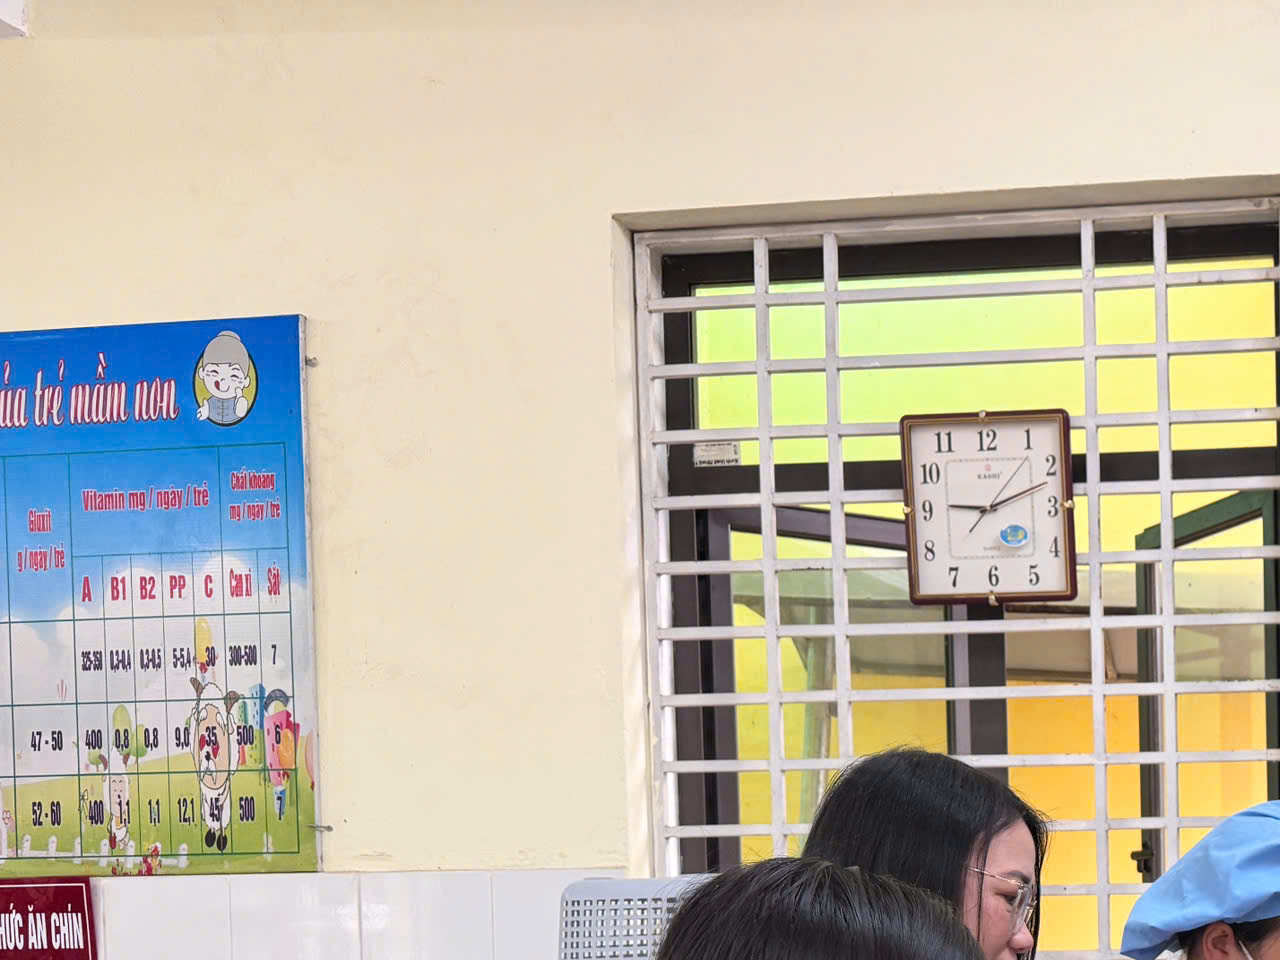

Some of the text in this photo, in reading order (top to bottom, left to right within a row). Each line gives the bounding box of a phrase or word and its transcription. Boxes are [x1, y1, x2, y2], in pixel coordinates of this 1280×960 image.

[33, 358, 65, 427] trẻ
[69, 351, 130, 426] mầm
[133, 375, 181, 421] non
[934, 431, 954, 454] 11
[977, 428, 998, 452] 12
[1024, 427, 1034, 450] 1
[920, 462, 941, 485] 10
[1045, 454, 1058, 477] 2
[82, 488, 126, 512] Vitamin
[128, 490, 146, 512] mg
[156, 485, 183, 511] ngày
[193, 481, 209, 506] trẻ
[1047, 495, 1060, 518] 3
[28, 508, 52, 533] Gluxit
[922, 499, 934, 522] 9
[17, 551, 23, 573] g
[29, 546, 48, 572] ngày
[924, 539, 936, 562] 8
[1049, 536, 1061, 559] 4
[139, 575, 156, 600] B2
[169, 574, 186, 599] PP
[204, 574, 213, 599] C
[229, 567, 252, 598] Can xi
[267, 560, 281, 597] Sắt
[948, 566, 960, 588] 7
[988, 565, 1000, 588] 6
[1028, 564, 1041, 587] 5
[81, 575, 92, 602] A
[110, 576, 126, 601] B1
[172, 647, 192, 671] 5-5,4
[205, 646, 216, 668] 30
[228, 644, 258, 667] 300-500
[271, 644, 277, 665] 7
[30, 730, 43, 752] 47
[51, 729, 63, 752] 50
[85, 729, 103, 750] 400
[114, 728, 130, 752] 0,8
[143, 727, 159, 751] 0,8
[174, 726, 190, 750] 9,0
[205, 725, 218, 747] 35
[236, 724, 255, 746] 500
[274, 724, 281, 745] 6
[31, 801, 43, 827] 52
[50, 800, 62, 827] 60
[88, 799, 105, 826] 400
[147, 798, 160, 827] 1,1
[176, 797, 195, 826] 12,1
[238, 796, 256, 822] 500
[276, 795, 283, 821] 7
[27, 904, 48, 950] ĂN
[50, 903, 84, 950] CHÍN
